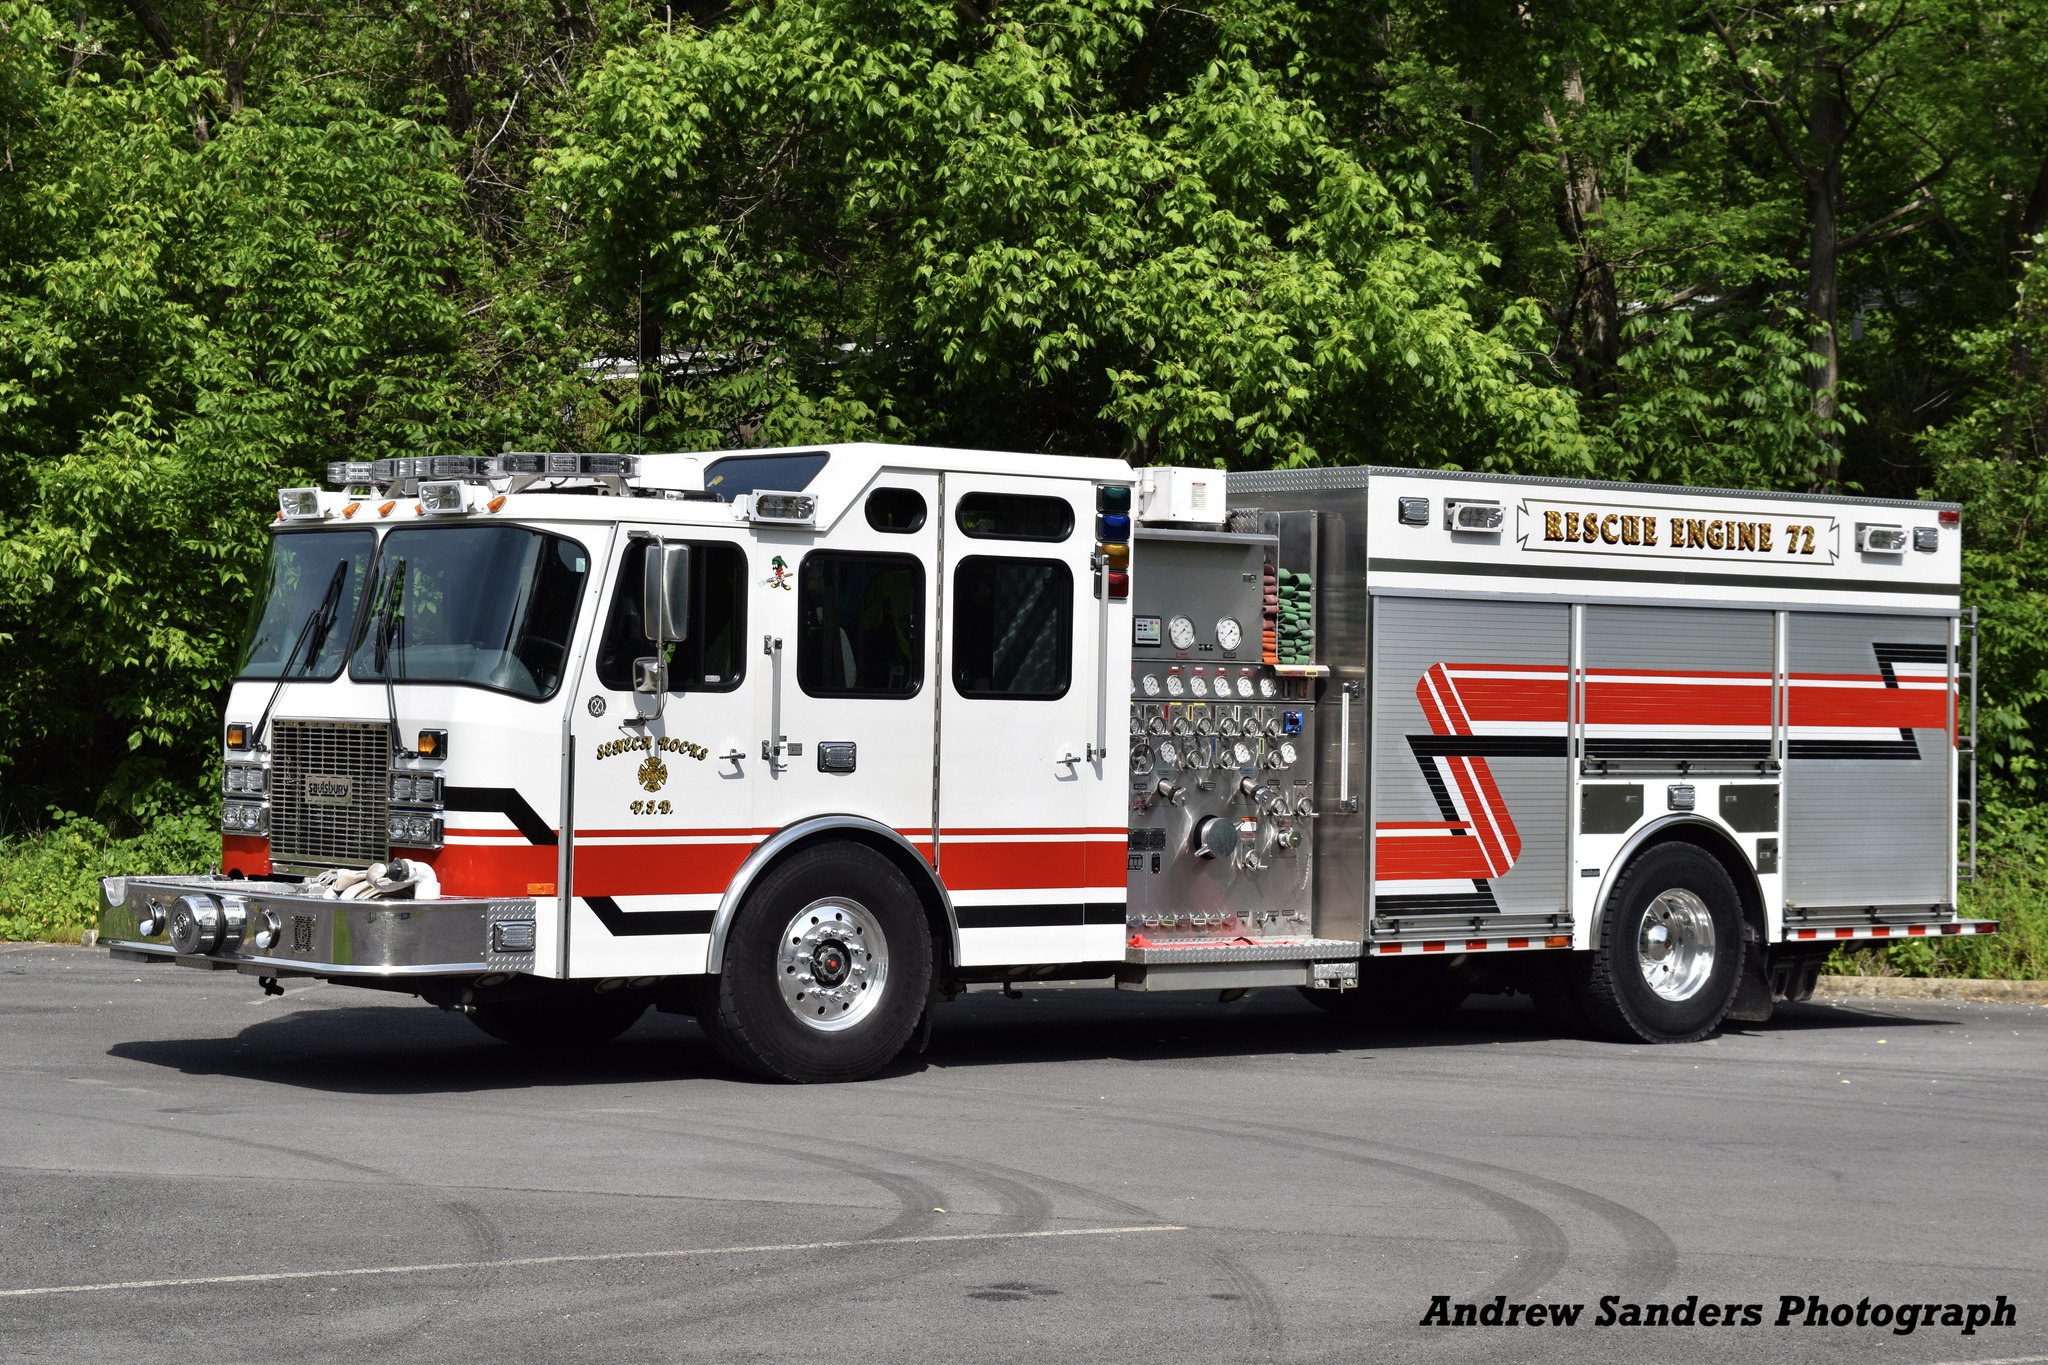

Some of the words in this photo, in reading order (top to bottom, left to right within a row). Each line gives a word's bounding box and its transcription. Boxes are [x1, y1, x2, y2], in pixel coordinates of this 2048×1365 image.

[1543, 510, 1658, 547] RESCUE
[1669, 517, 1774, 552] ENGINE
[1784, 524, 1817, 555] 72
[596, 735, 653, 761] SENECA
[657, 735, 709, 761] ROCKS
